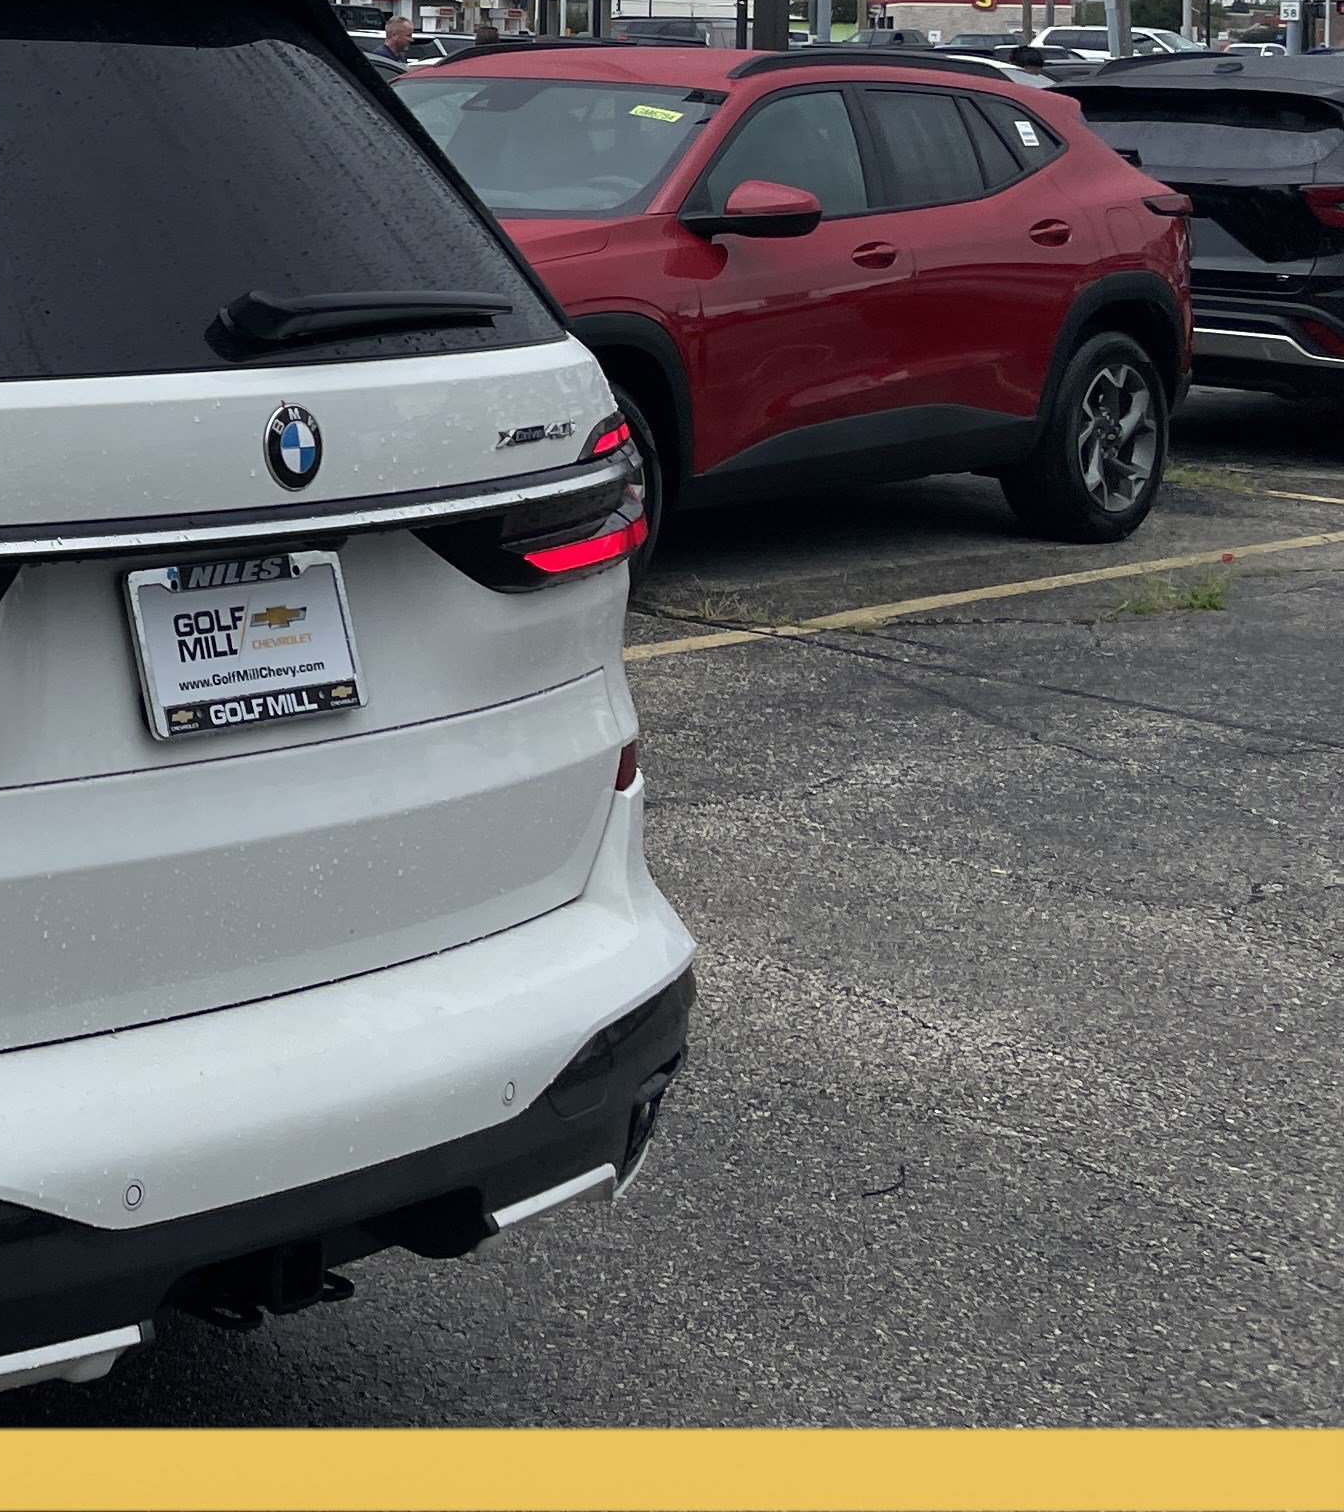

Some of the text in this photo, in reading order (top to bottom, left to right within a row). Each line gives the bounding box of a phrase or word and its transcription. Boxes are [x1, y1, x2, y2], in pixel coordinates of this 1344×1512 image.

[1283, 9, 1297, 19] 58
[272, 407, 317, 436] BMW
[188, 557, 283, 588] NILES
[173, 605, 246, 638] GOLF
[177, 633, 239, 663] MILL
[252, 633, 312, 650] CHEVROLET
[178, 660, 325, 691] www.GolfMillChevy.com
[209, 691, 318, 725] GOLF MILL
